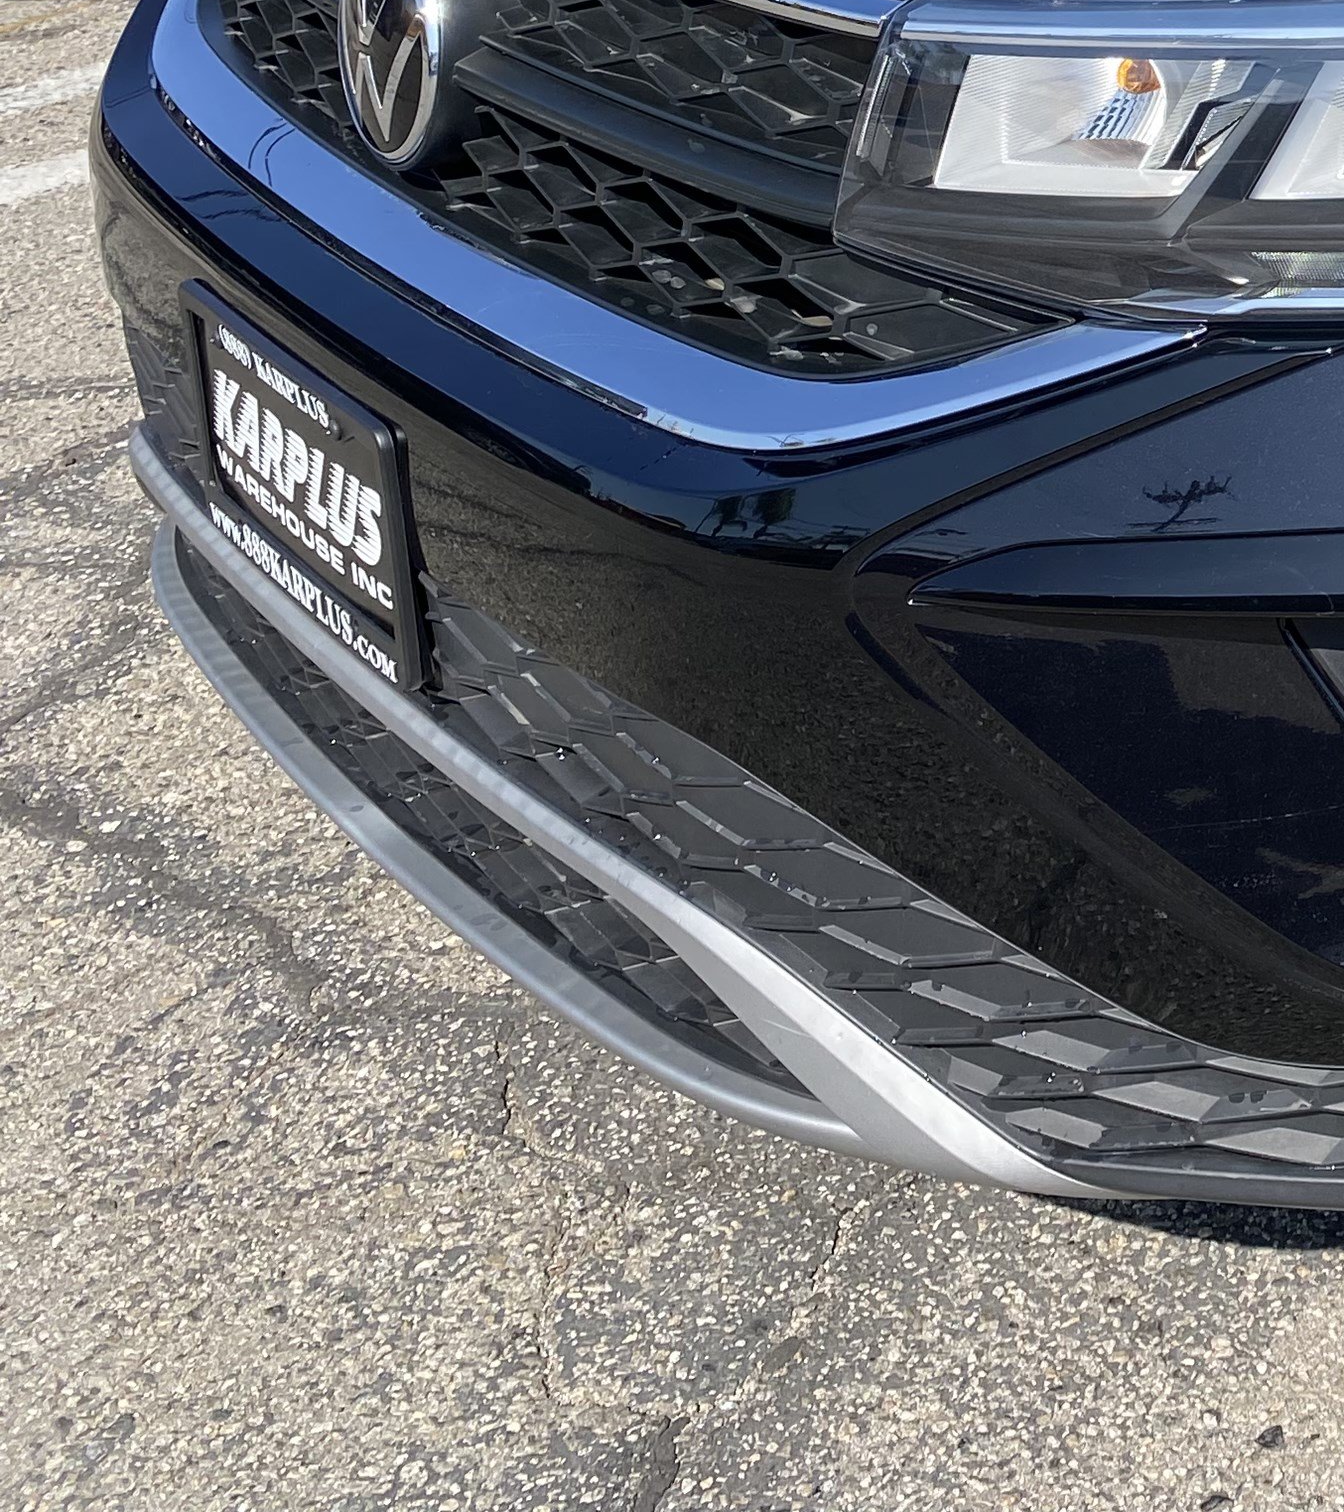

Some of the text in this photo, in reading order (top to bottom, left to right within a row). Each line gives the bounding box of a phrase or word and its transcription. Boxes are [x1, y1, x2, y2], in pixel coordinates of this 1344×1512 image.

[217, 323, 330, 428] (888) KARPLUS
[213, 368, 383, 566] KARPLUS
[215, 443, 395, 611] WAREHOUSE INC
